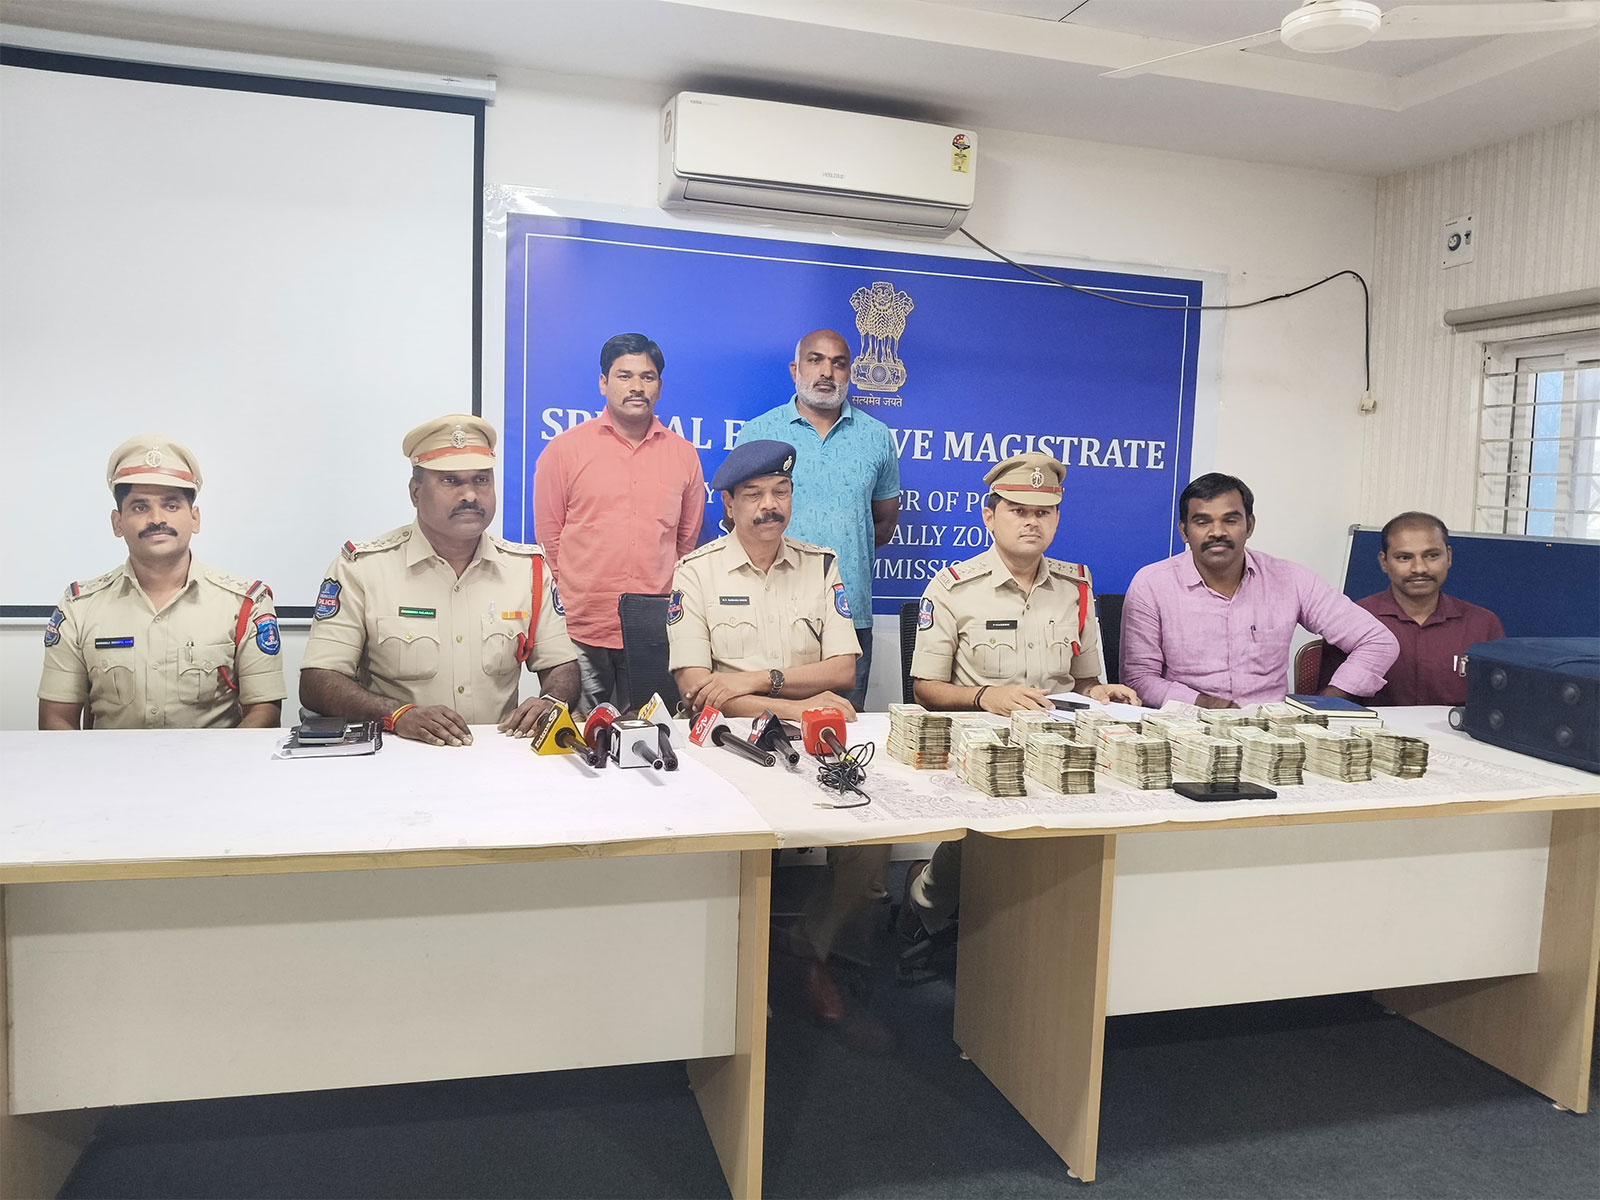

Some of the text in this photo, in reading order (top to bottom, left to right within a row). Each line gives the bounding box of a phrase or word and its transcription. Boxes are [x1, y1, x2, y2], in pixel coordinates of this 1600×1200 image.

[852, 393, 903, 408] सत्यमेव जयते
[942, 430, 1165, 469] MAGISTRATE
[928, 490, 959, 512] OF
[952, 526, 996, 548] ZON
